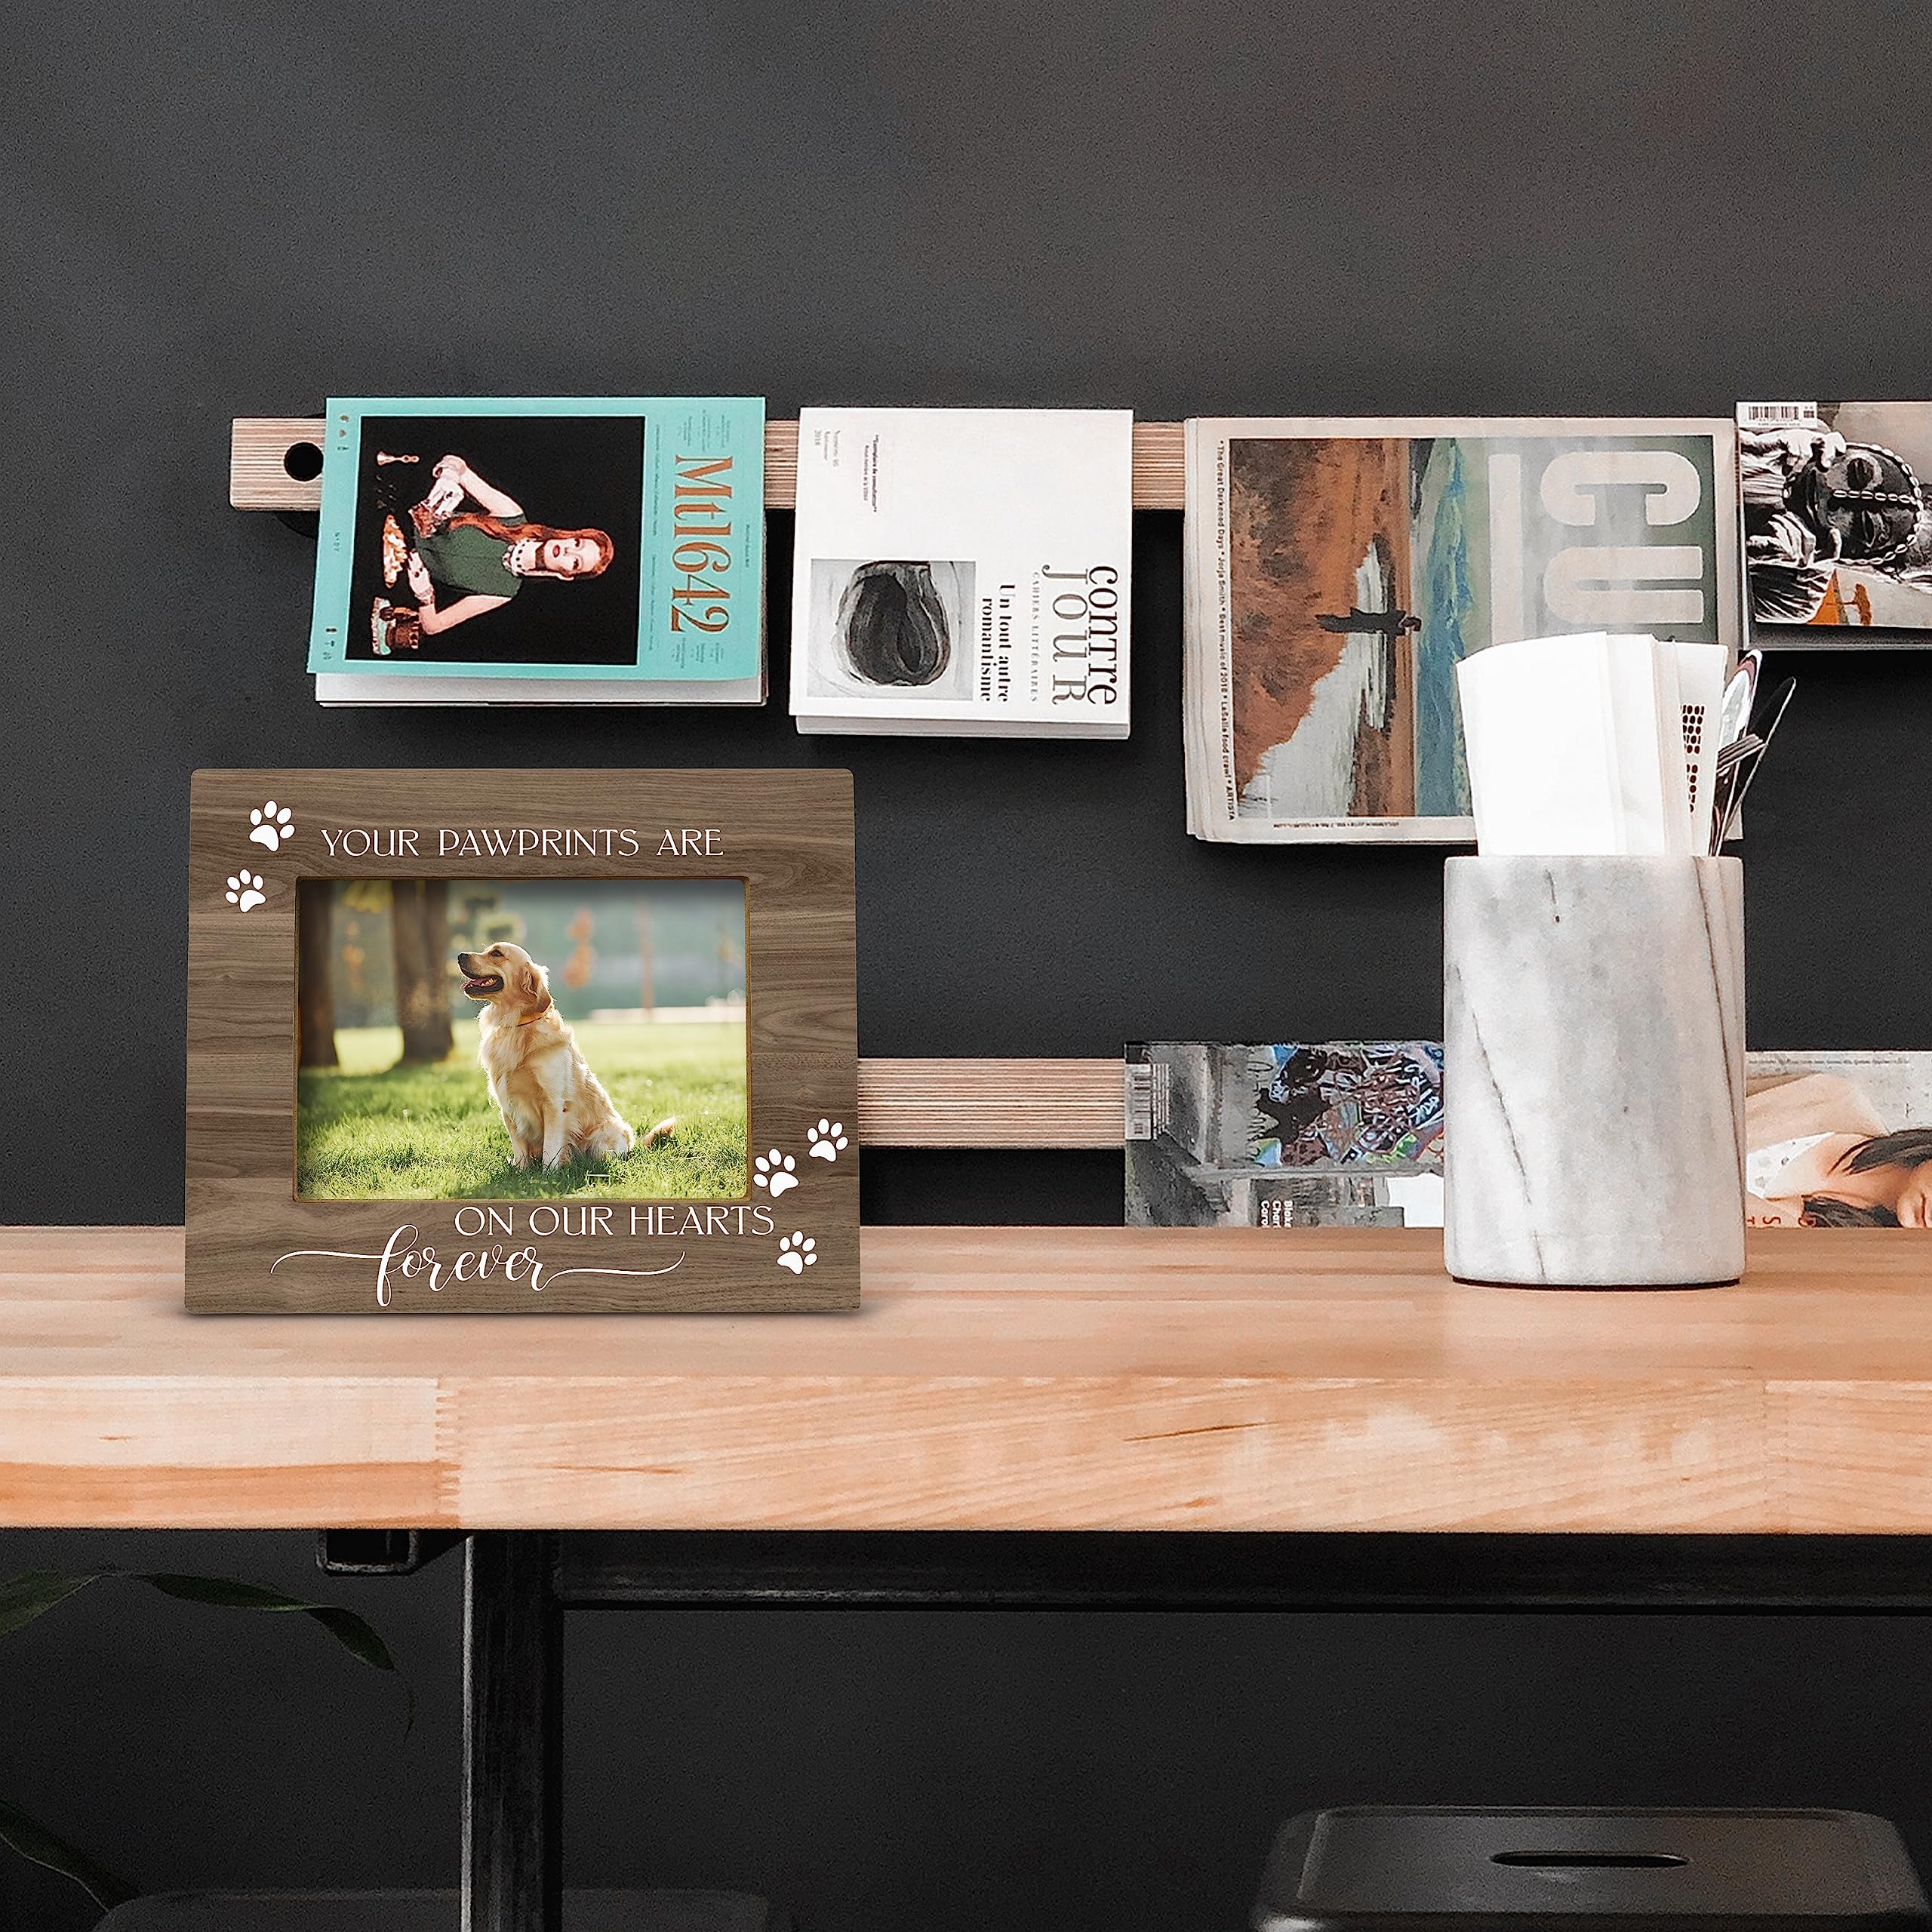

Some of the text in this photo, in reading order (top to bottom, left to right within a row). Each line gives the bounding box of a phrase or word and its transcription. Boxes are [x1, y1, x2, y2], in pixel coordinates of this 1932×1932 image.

[1217, 446, 1225, 460] The
[1217, 462, 1225, 486] Great
[1217, 487, 1225, 528] Darkened
[1216, 528, 1226, 549] Days
[998, 584, 1016, 609] Un
[980, 598, 998, 703] romantisme
[997, 655, 1011, 703] autre
[1222, 734, 1231, 753] food
[1222, 755, 1232, 778] crawl
[321, 829, 724, 857] YOUR PAWPRINTS ARE
[454, 1204, 775, 1236] ON OUR HEARTS
